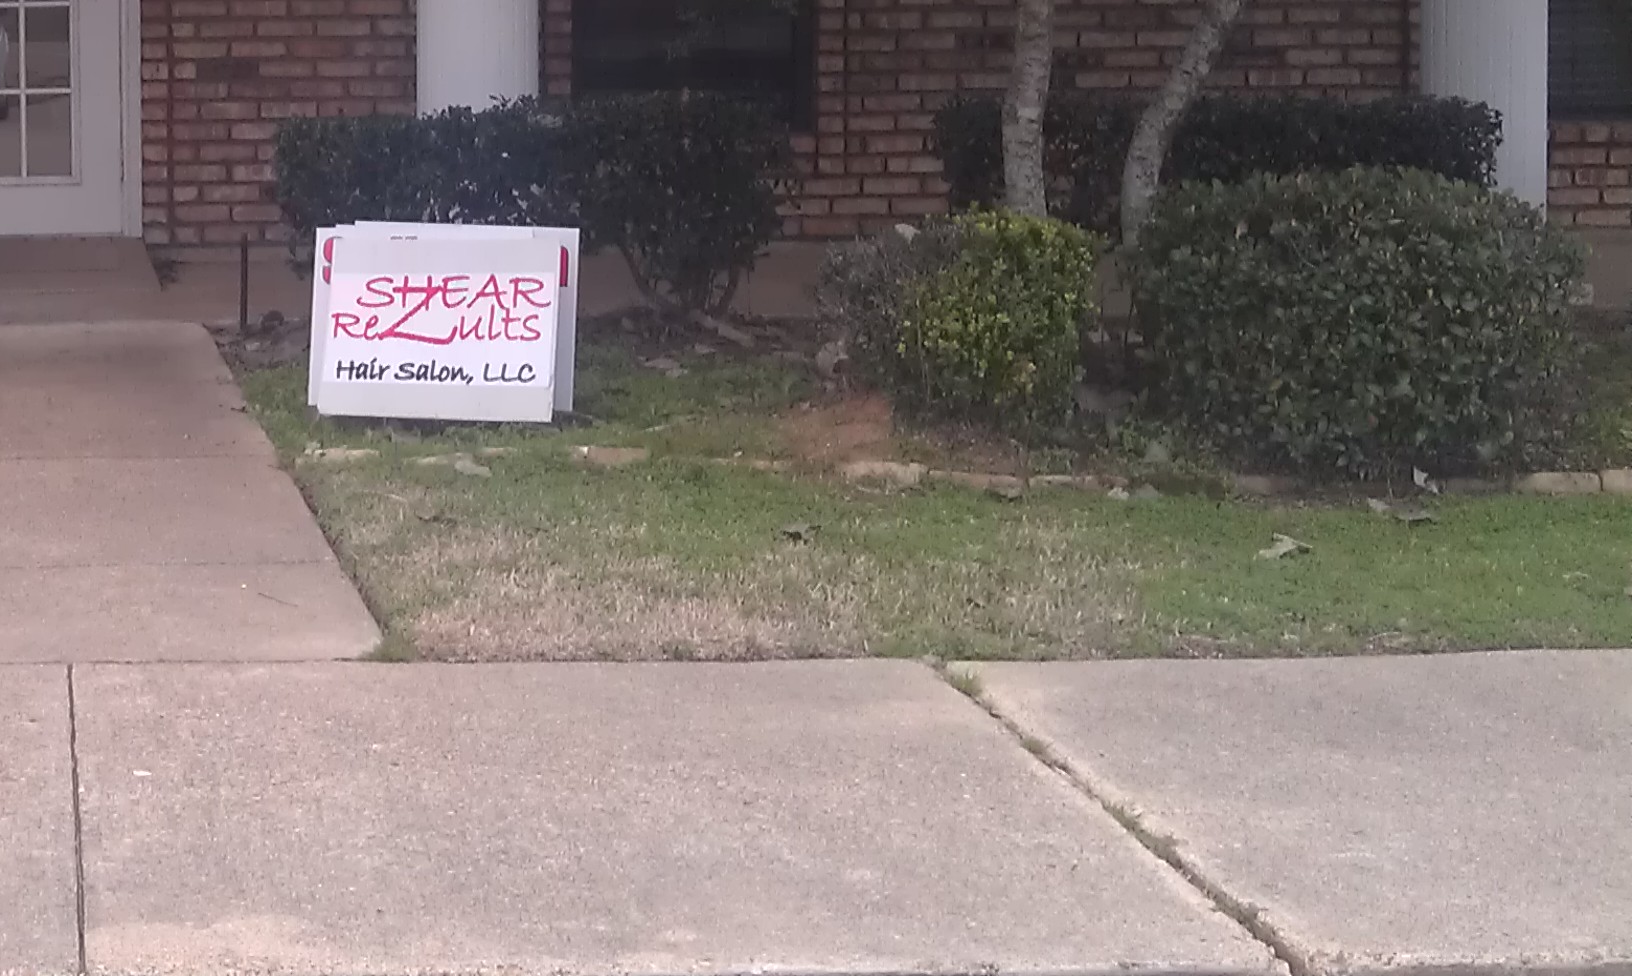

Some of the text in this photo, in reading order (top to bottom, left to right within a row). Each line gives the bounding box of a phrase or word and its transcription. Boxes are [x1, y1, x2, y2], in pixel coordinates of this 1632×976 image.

[356, 274, 552, 311] SHEAR
[336, 358, 537, 385] Hair Salon, LLC
